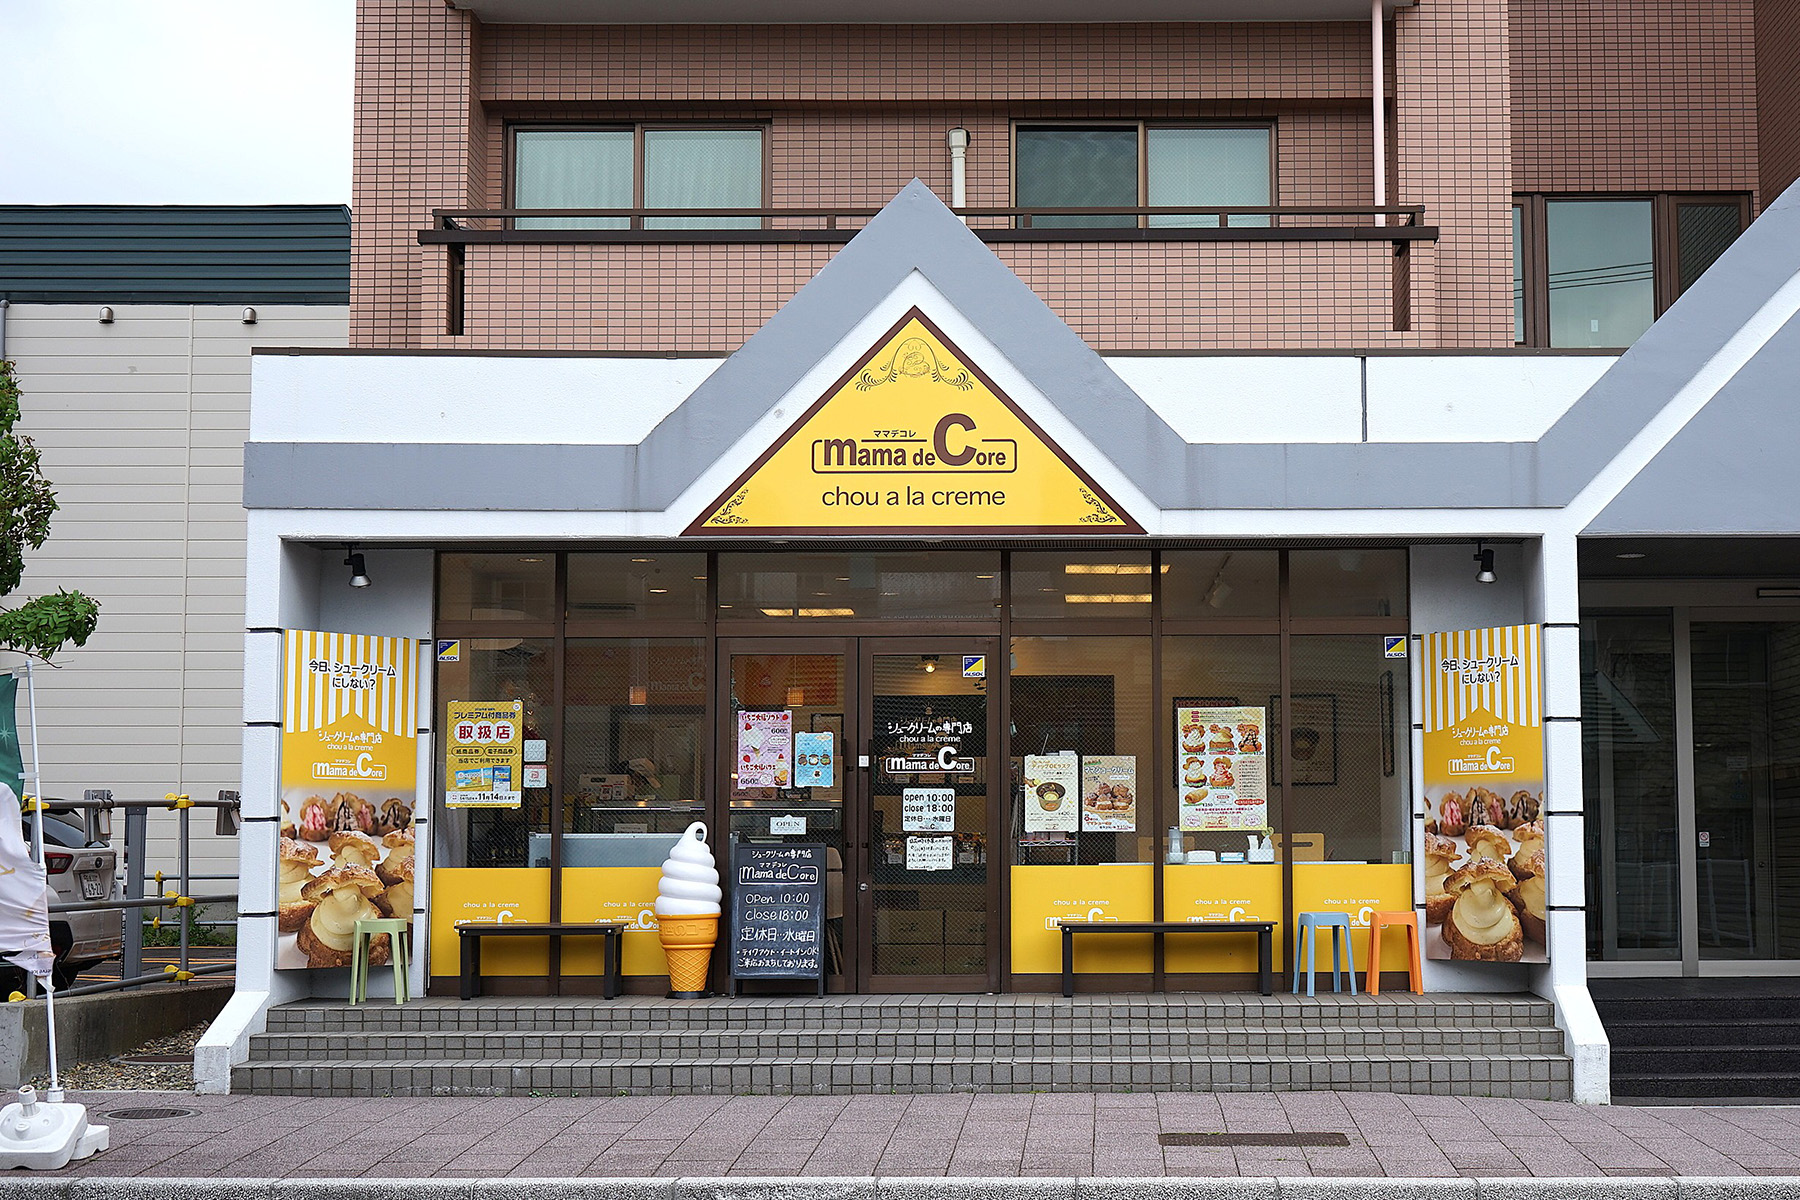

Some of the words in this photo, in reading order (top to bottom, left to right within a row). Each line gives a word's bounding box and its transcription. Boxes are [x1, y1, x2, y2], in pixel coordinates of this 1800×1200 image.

[824, 438, 906, 466] mama
[933, 413, 1006, 466] Core
[822, 486, 879, 505] chou
[886, 491, 899, 505] a
[907, 486, 924, 505] la
[932, 491, 1006, 505] creme
[308, 660, 396, 676] 今日、シュークリーム
[1441, 656, 1519, 671] 今日、シュークリーム
[332, 678, 376, 690] にしない？
[1462, 671, 1500, 684] にしない？
[459, 726, 510, 739] 取扱店
[888, 721, 972, 734] シュークリームの専門店
[1452, 725, 1509, 738] シュークリームの専門店
[318, 730, 382, 743] シュークリームの専門店
[891, 757, 926, 769] mama
[938, 746, 970, 770] Core
[1452, 758, 1478, 771] mama
[1486, 746, 1510, 770] Core
[317, 762, 347, 776] mama
[357, 753, 382, 777] Core
[927, 794, 953, 802] 10:00
[904, 804, 924, 812] close
[927, 804, 953, 812] 18:00
[752, 849, 812, 859] シュークリームの専門店
[780, 893, 810, 904] 10:00
[638, 910, 659, 929] Co
[745, 908, 777, 921] Close
[779, 910, 808, 921] 18:00
